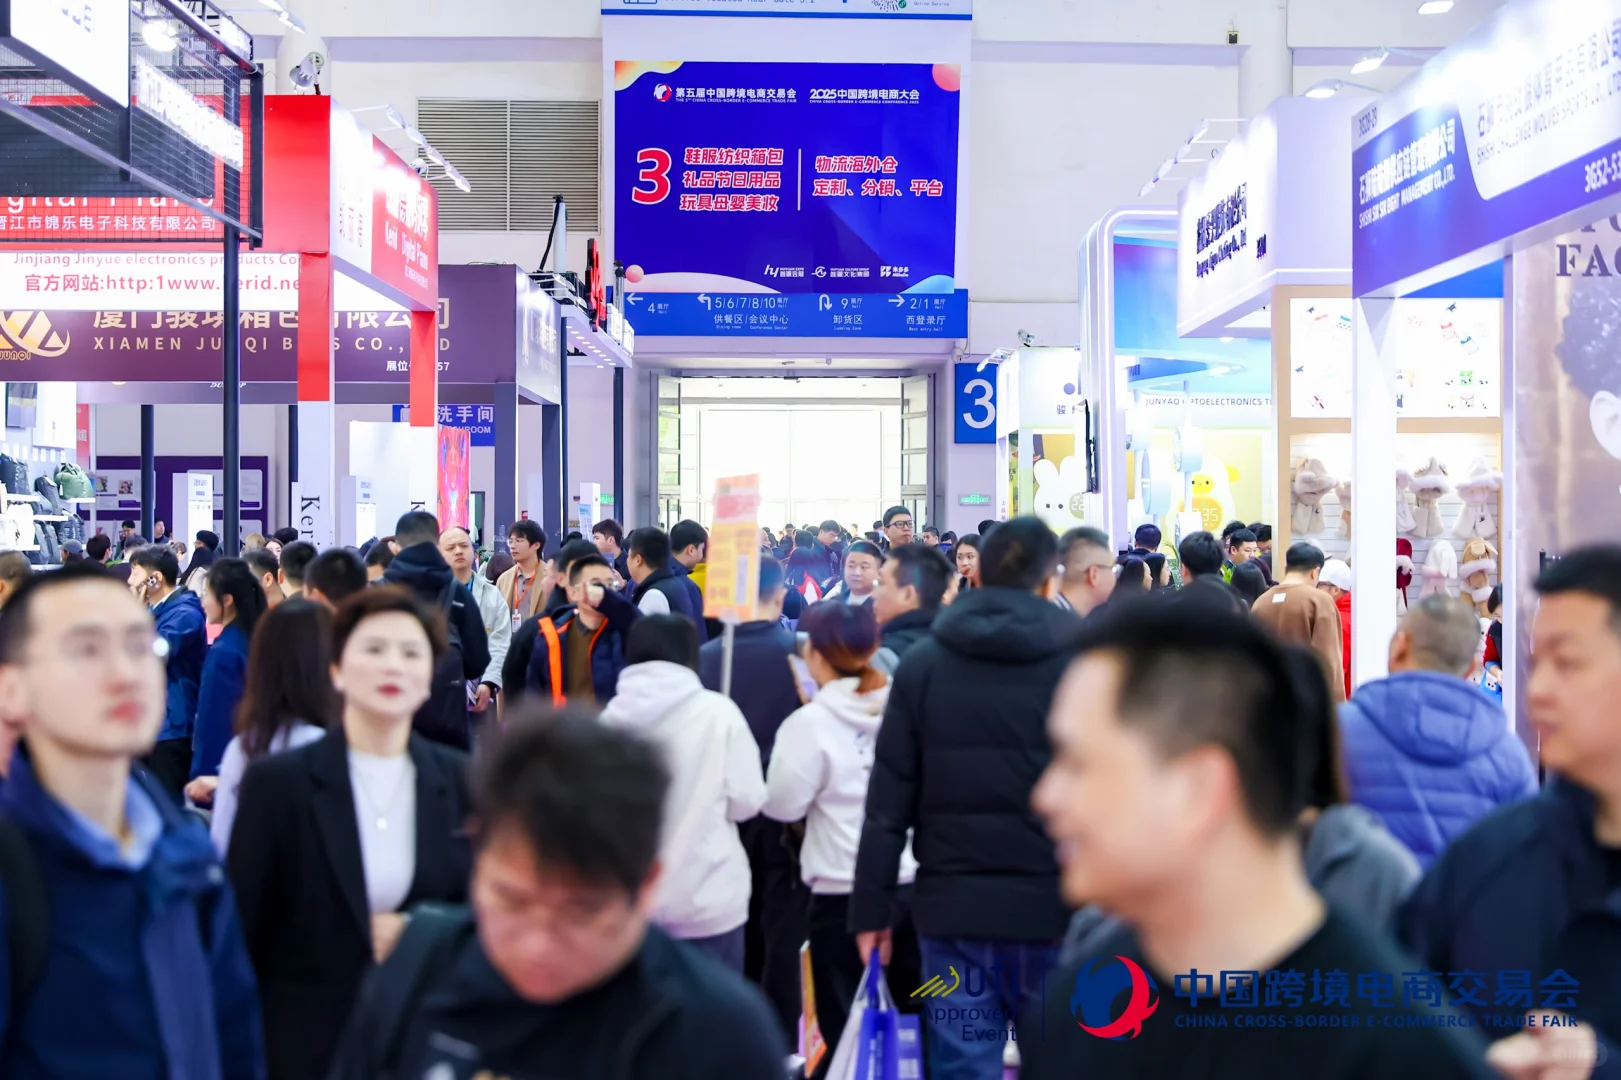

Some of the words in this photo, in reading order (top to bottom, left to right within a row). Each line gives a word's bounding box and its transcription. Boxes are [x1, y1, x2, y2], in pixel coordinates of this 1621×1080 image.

[676, 87, 797, 99] 第五届中国跨境电商交易会
[810, 88, 920, 100] 2025中国跨境电商大会
[684, 147, 784, 166] 鞋服纺织箱包
[815, 155, 898, 174] 物流海外仓
[632, 148, 672, 205] 3
[682, 170, 782, 189] 礼品节日用品
[679, 193, 780, 212] 玩具母婴美妆
[14, 253, 70, 267] Jinjiang
[75, 253, 121, 267] Jinyue
[126, 252, 206, 264] electronics
[211, 253, 275, 267] prducts
[1556, 243, 1621, 277] FA
[648, 302, 655, 313] 4
[714, 297, 776, 309] 5/6/7/8/10
[841, 297, 849, 309] 9
[910, 297, 929, 310] 2/1
[833, 314, 863, 325] 卸货区
[906, 315, 946, 325] 西登录厅
[94, 337, 181, 351] XIAMEN
[196, 337, 267, 353] JUQI
[283, 337, 340, 351] BS
[963, 379, 997, 429] 3
[1145, 398, 1181, 406] JUNYAO
[437, 405, 494, 423] 洗手间
